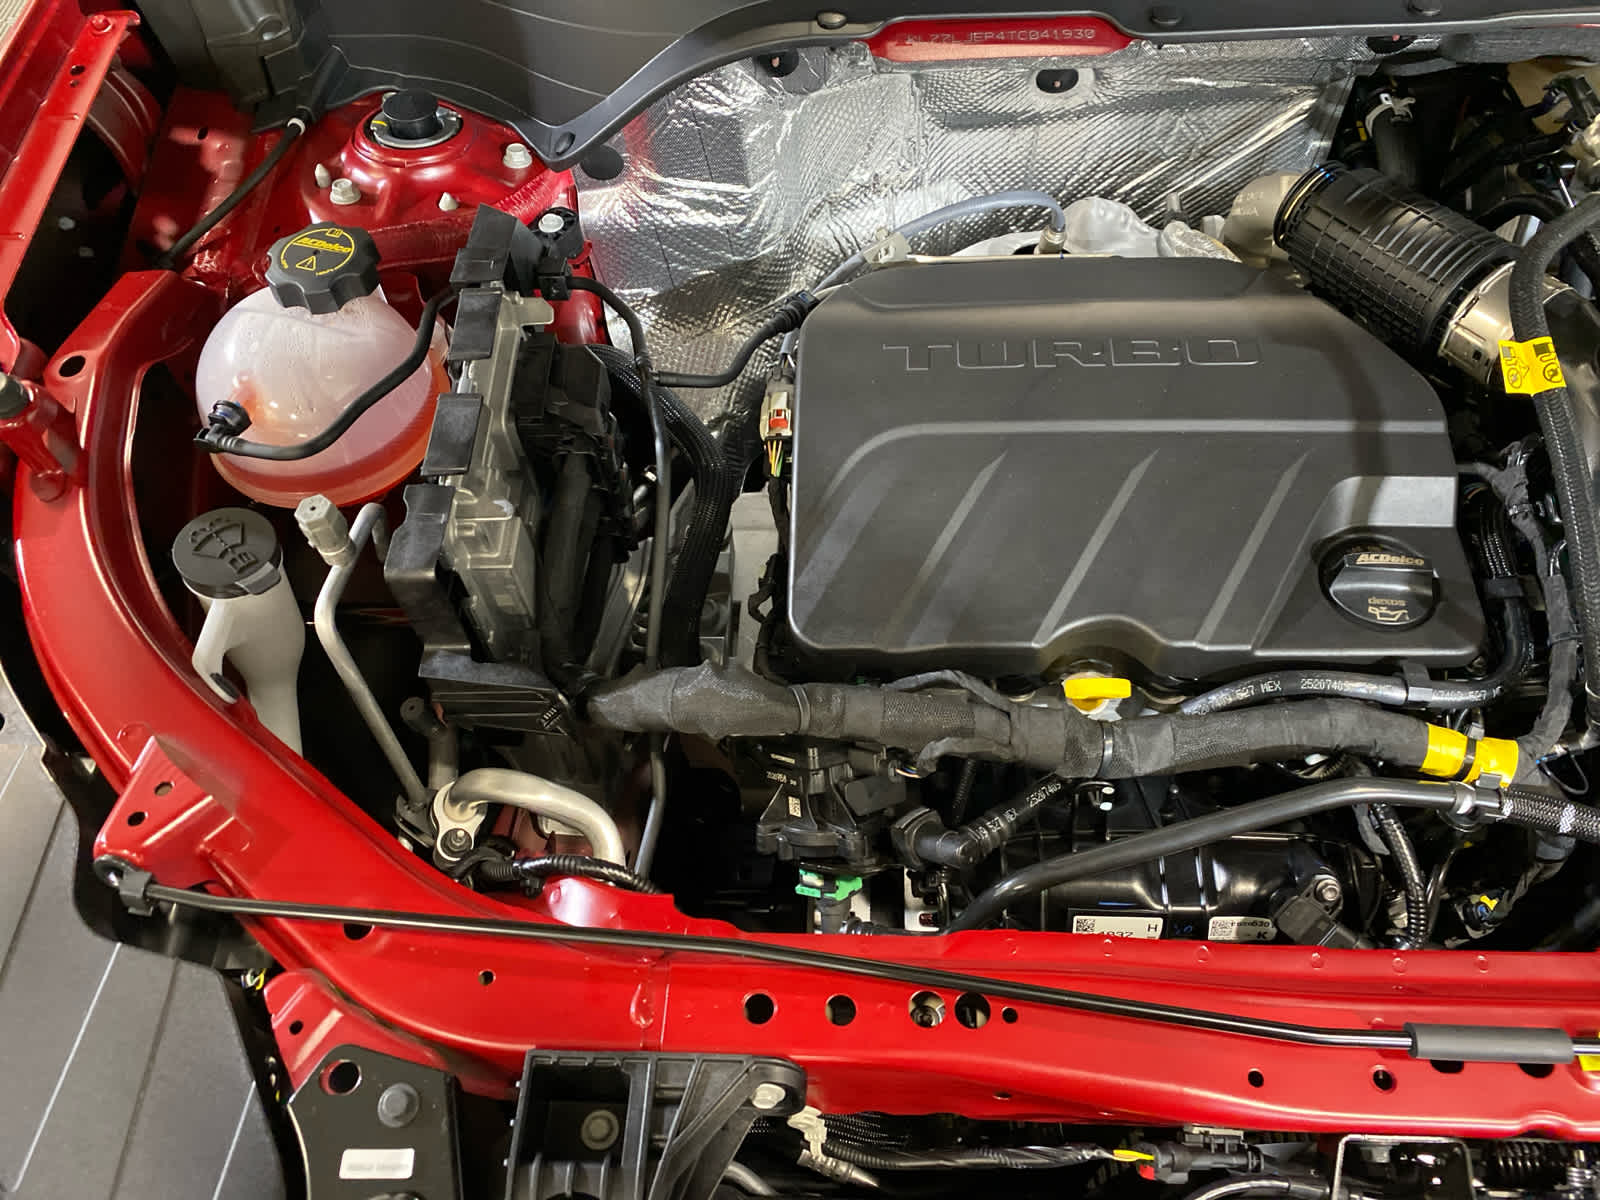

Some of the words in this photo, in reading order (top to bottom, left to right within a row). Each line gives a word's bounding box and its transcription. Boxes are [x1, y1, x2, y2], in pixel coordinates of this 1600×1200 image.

[882, 338, 1260, 371] TURBO
[1356, 553, 1425, 566] ACDelco
[1260, 680, 1282, 693] MEX
[1147, 923, 1158, 932] H
